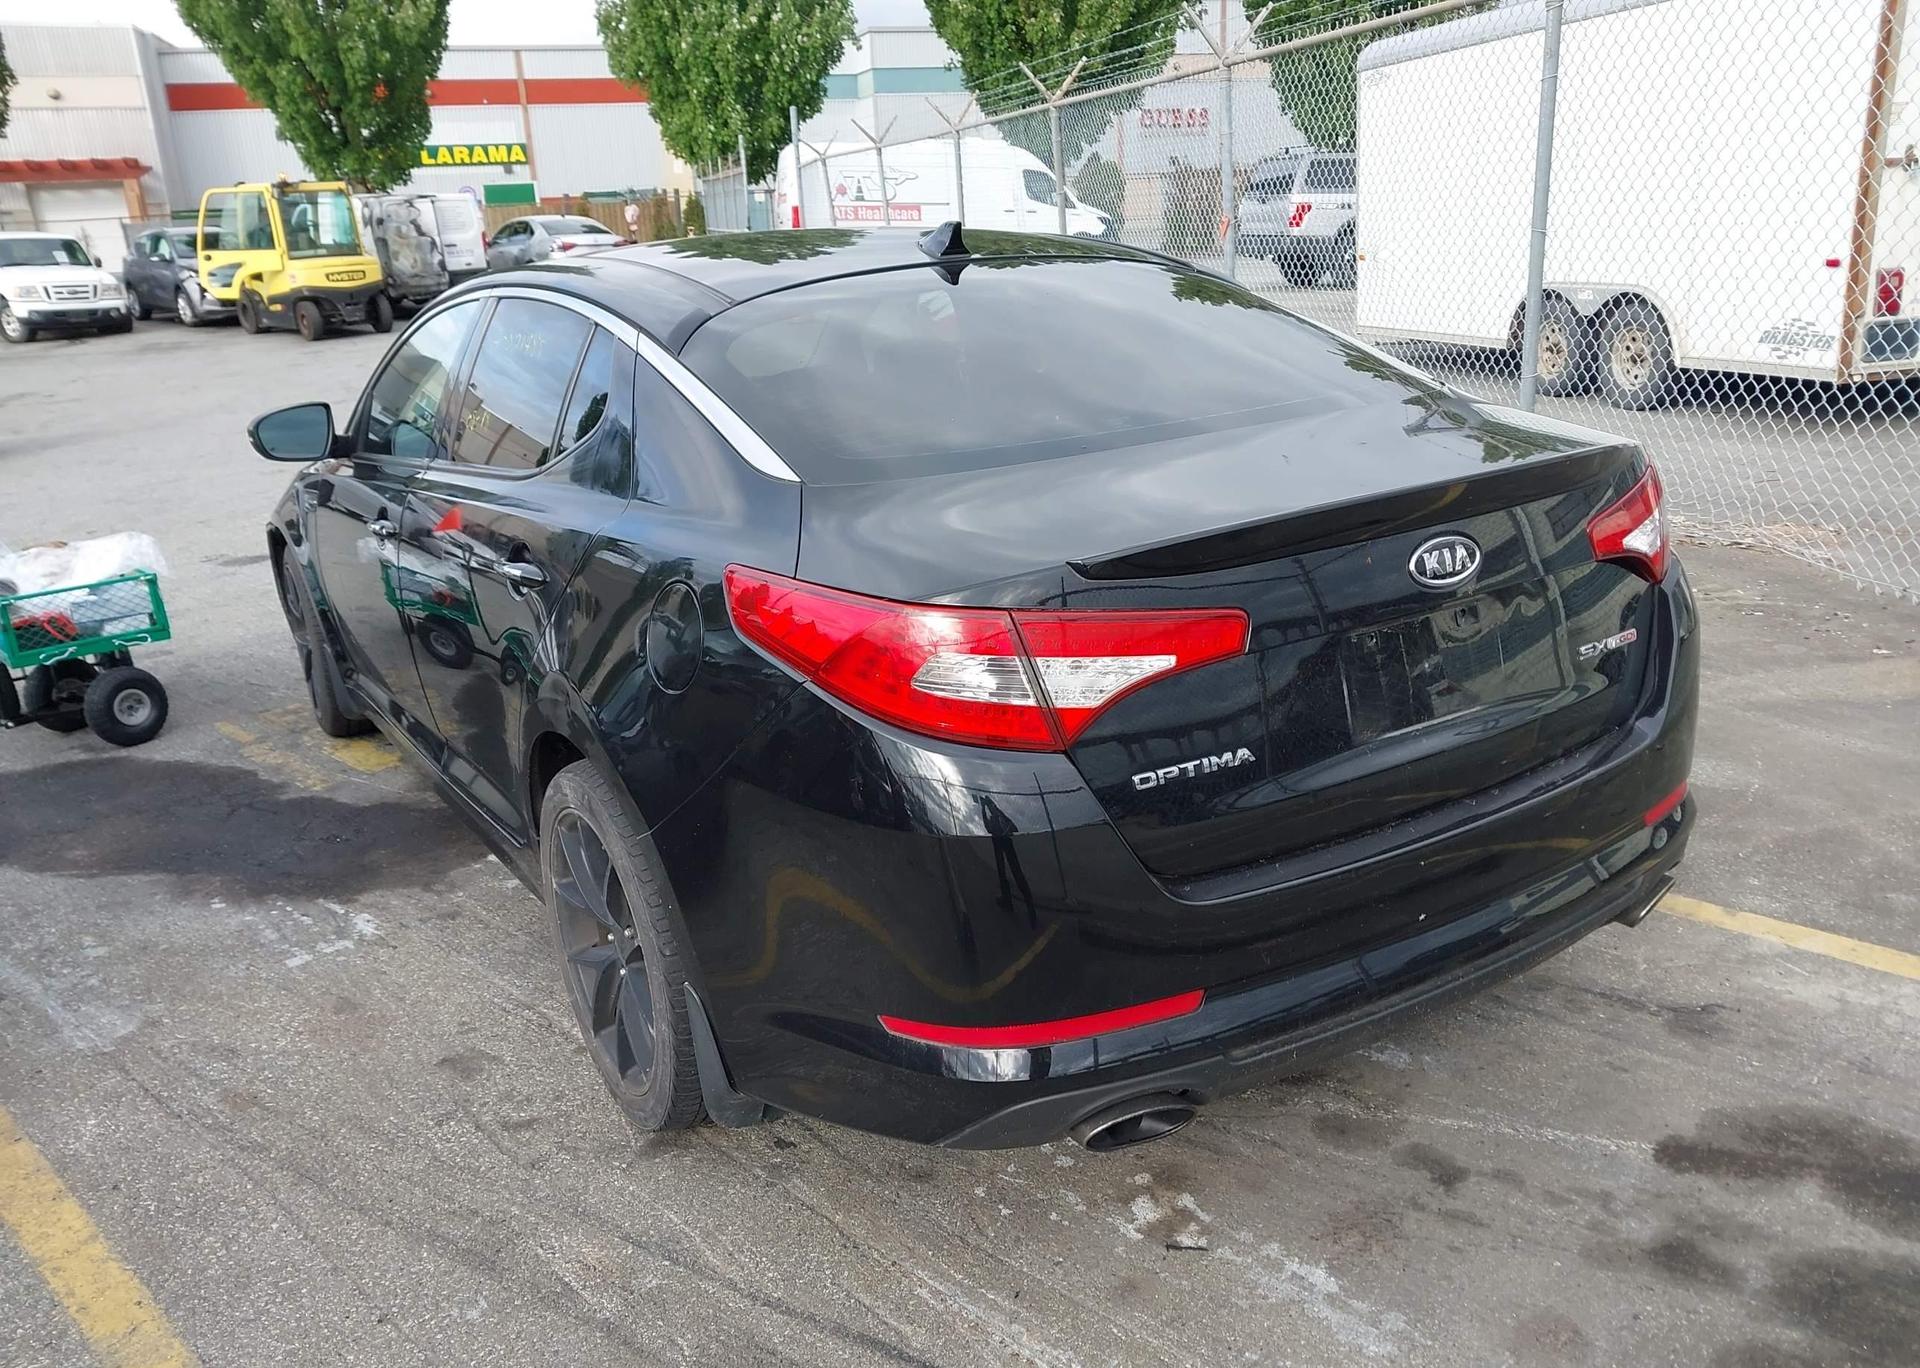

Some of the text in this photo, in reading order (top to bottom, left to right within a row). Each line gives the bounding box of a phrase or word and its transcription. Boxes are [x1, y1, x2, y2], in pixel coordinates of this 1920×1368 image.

[421, 145, 526, 164] LARAMA
[833, 206, 920, 220] ATS Healhcare
[1758, 329, 1836, 350] DRAGSTER
[1422, 545, 1472, 578] KIA
[1131, 748, 1256, 791] OPTIMA
